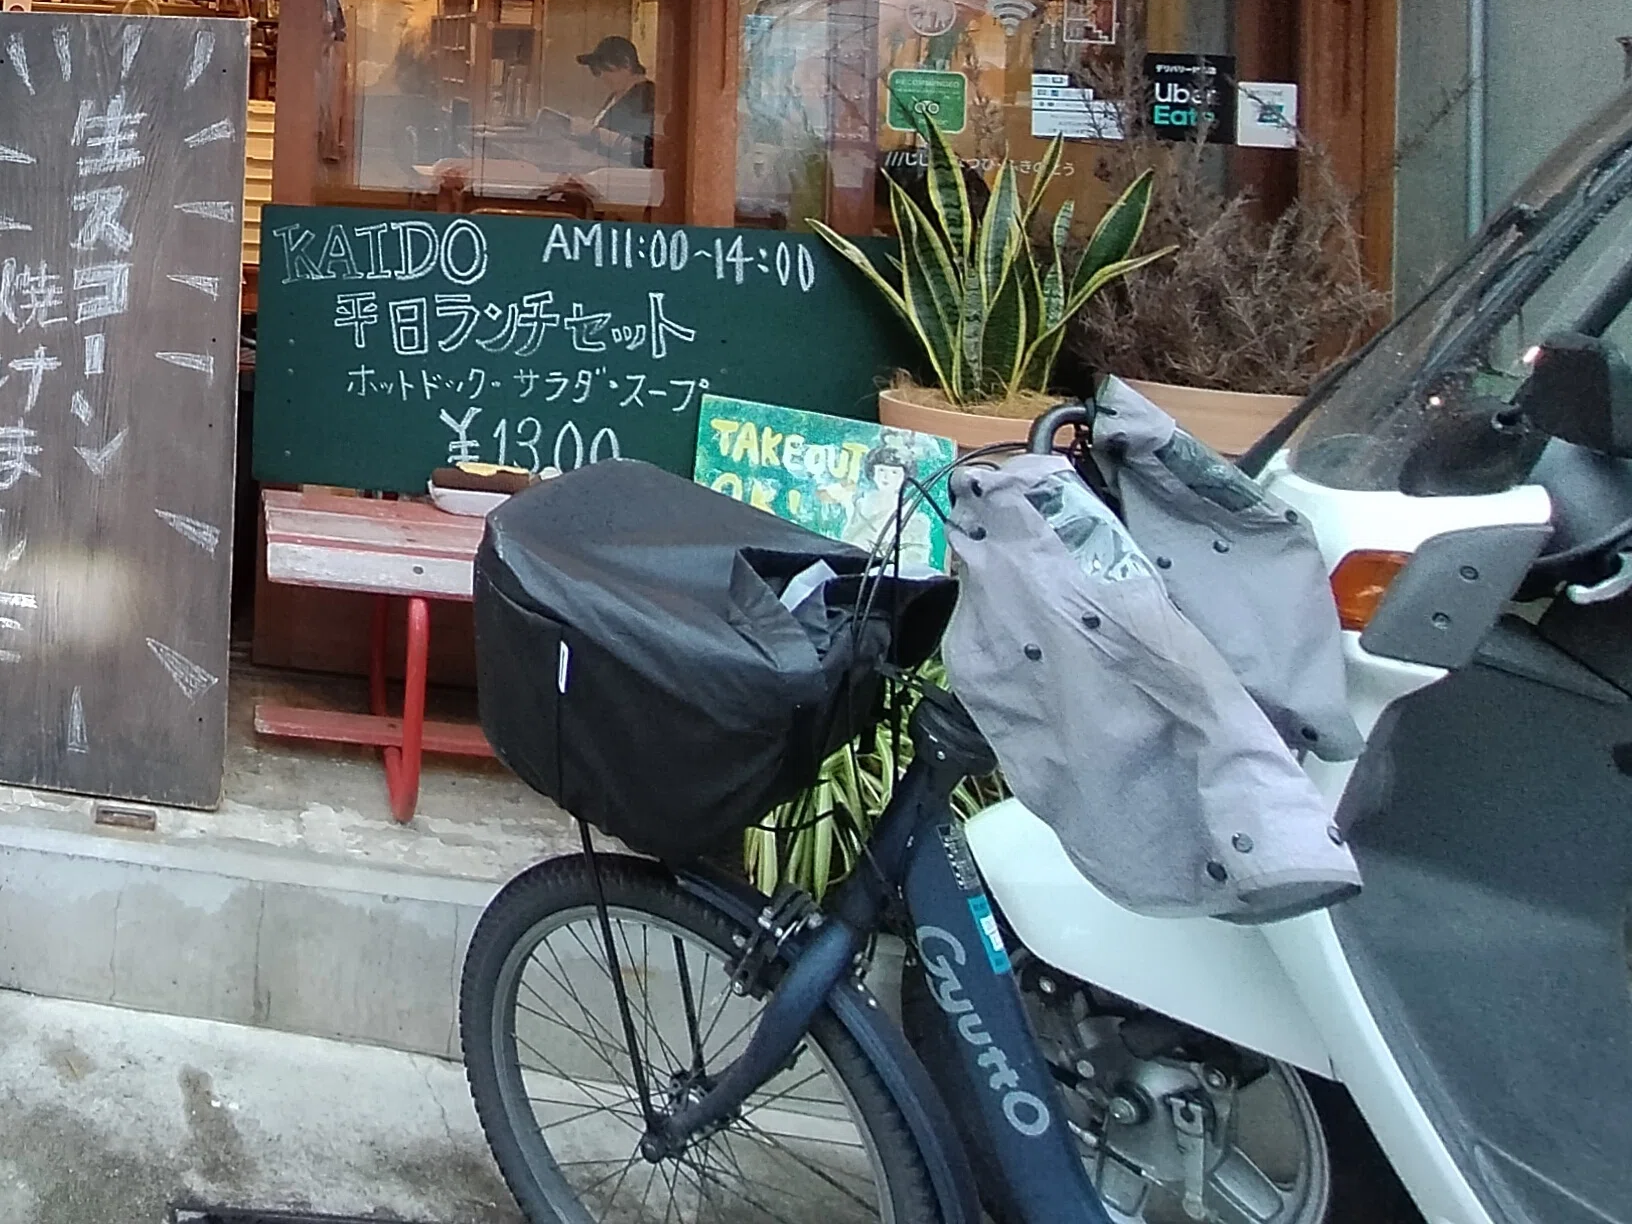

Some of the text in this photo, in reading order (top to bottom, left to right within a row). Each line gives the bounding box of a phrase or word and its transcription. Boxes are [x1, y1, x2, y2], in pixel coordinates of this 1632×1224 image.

[69, 94, 147, 476] 生スコーン
[273, 218, 489, 286] KAIDO
[334, 290, 696, 360] 平日ランチセット
